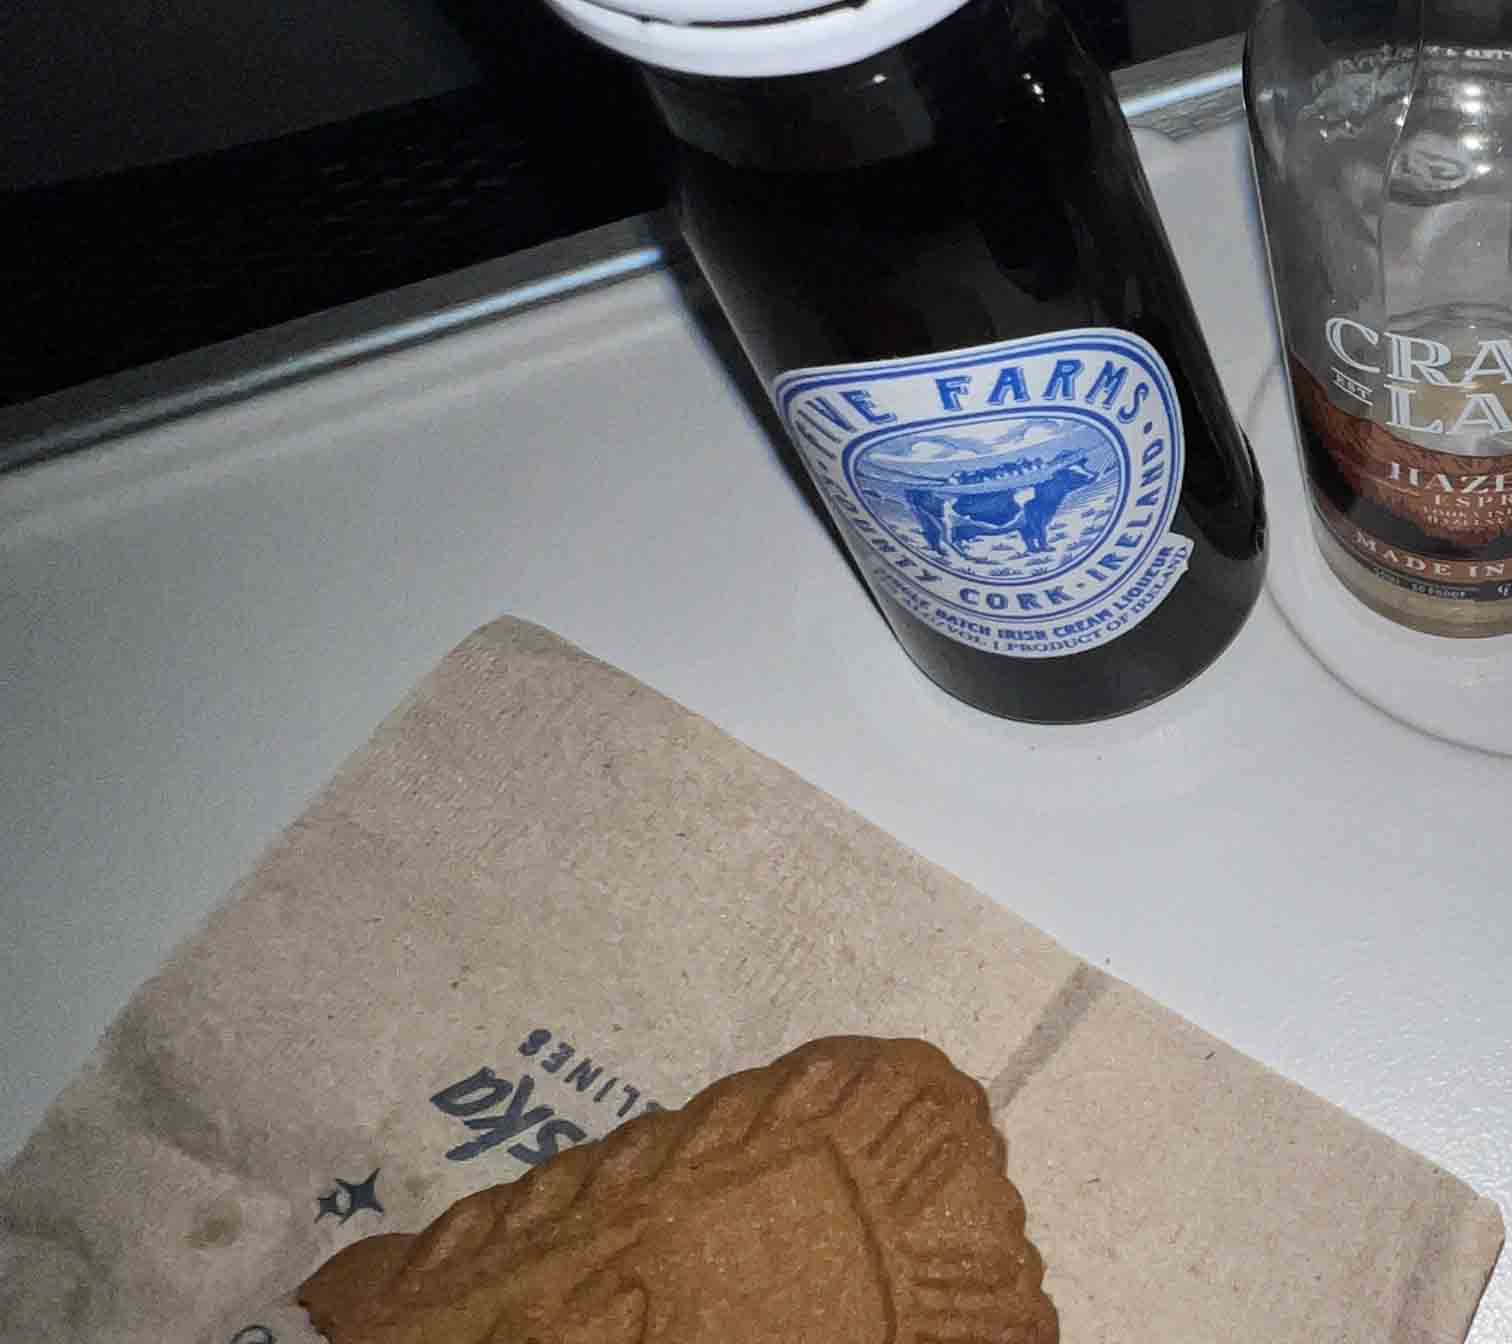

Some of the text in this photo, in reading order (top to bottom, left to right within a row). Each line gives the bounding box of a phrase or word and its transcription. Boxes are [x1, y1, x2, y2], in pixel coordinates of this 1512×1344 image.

[934, 358, 1150, 426] FARMS
[959, 586, 1076, 611] CORK
[1085, 438, 1164, 582] IRELAND
[1352, 527, 1452, 576] MADE
[1467, 563, 1505, 577] IN
[935, 608, 993, 639] BATCH
[1052, 608, 1115, 639] CREAM
[1111, 544, 1177, 612] LIQUEUR
